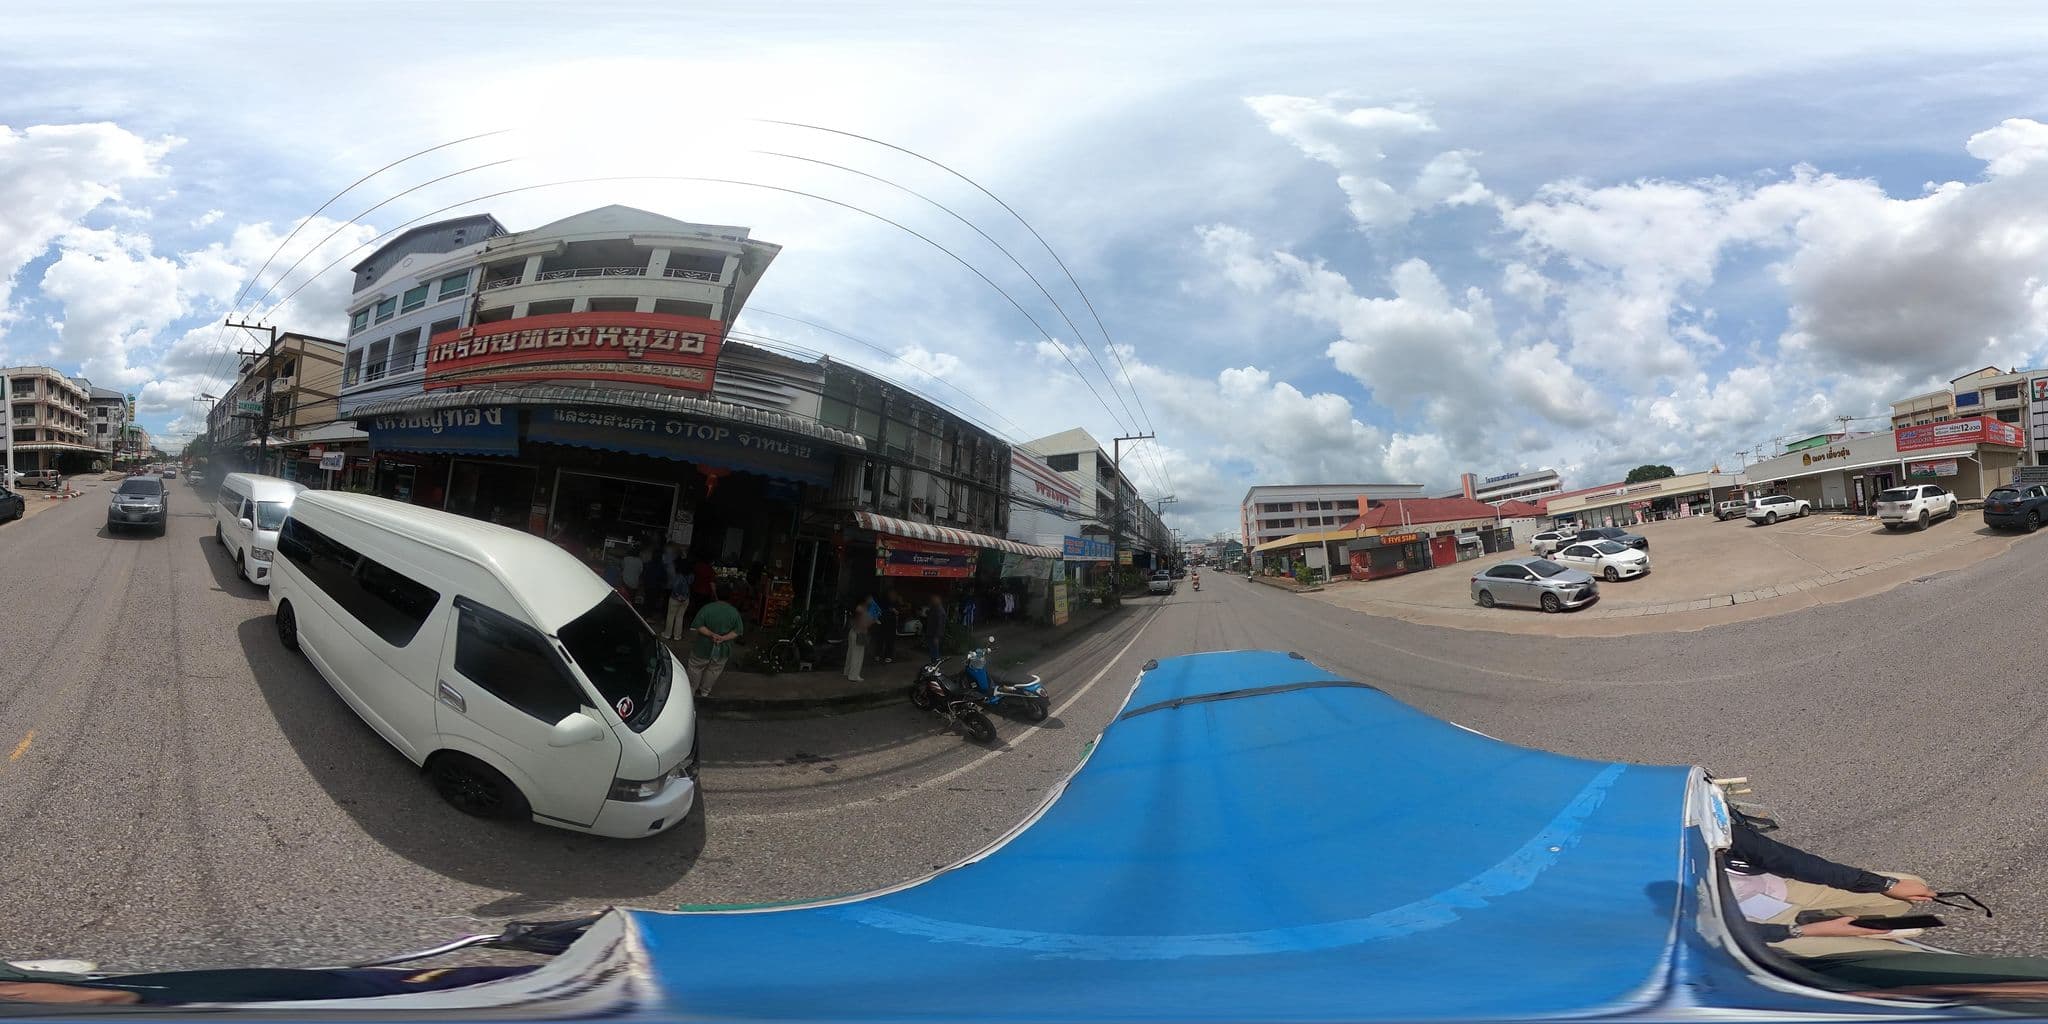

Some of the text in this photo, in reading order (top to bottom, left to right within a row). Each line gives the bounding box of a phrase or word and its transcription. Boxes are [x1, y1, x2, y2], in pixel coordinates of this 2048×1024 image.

[432, 326, 706, 362] เหรียญทองหมูยอ
[376, 408, 503, 433] เหรยญทอง
[666, 421, 730, 441] OTOP
[1388, 534, 1417, 544] FIVE STAR
